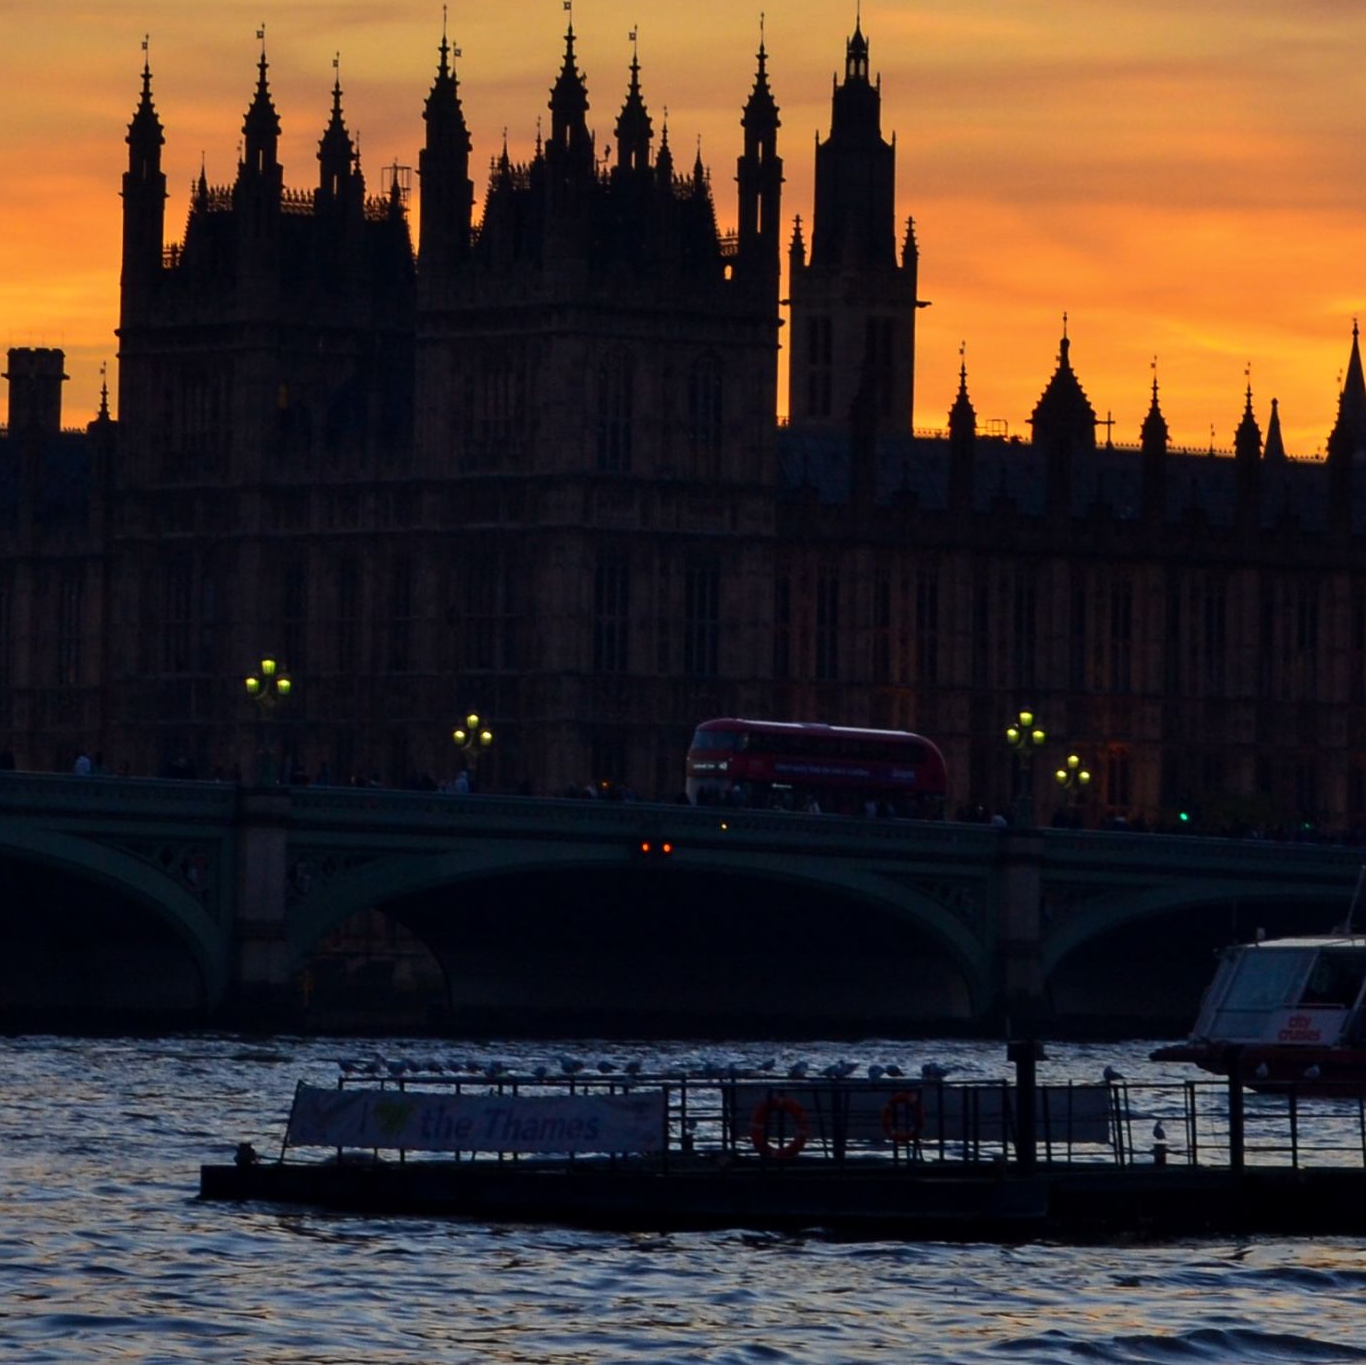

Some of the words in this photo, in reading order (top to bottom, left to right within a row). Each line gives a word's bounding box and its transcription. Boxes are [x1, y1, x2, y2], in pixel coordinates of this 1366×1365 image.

[1289, 1015, 1312, 1031] city
[1279, 1028, 1322, 1041] cruises
[360, 1101, 368, 1135] I
[421, 1106, 472, 1138] the
[482, 1108, 600, 1142] Thames
